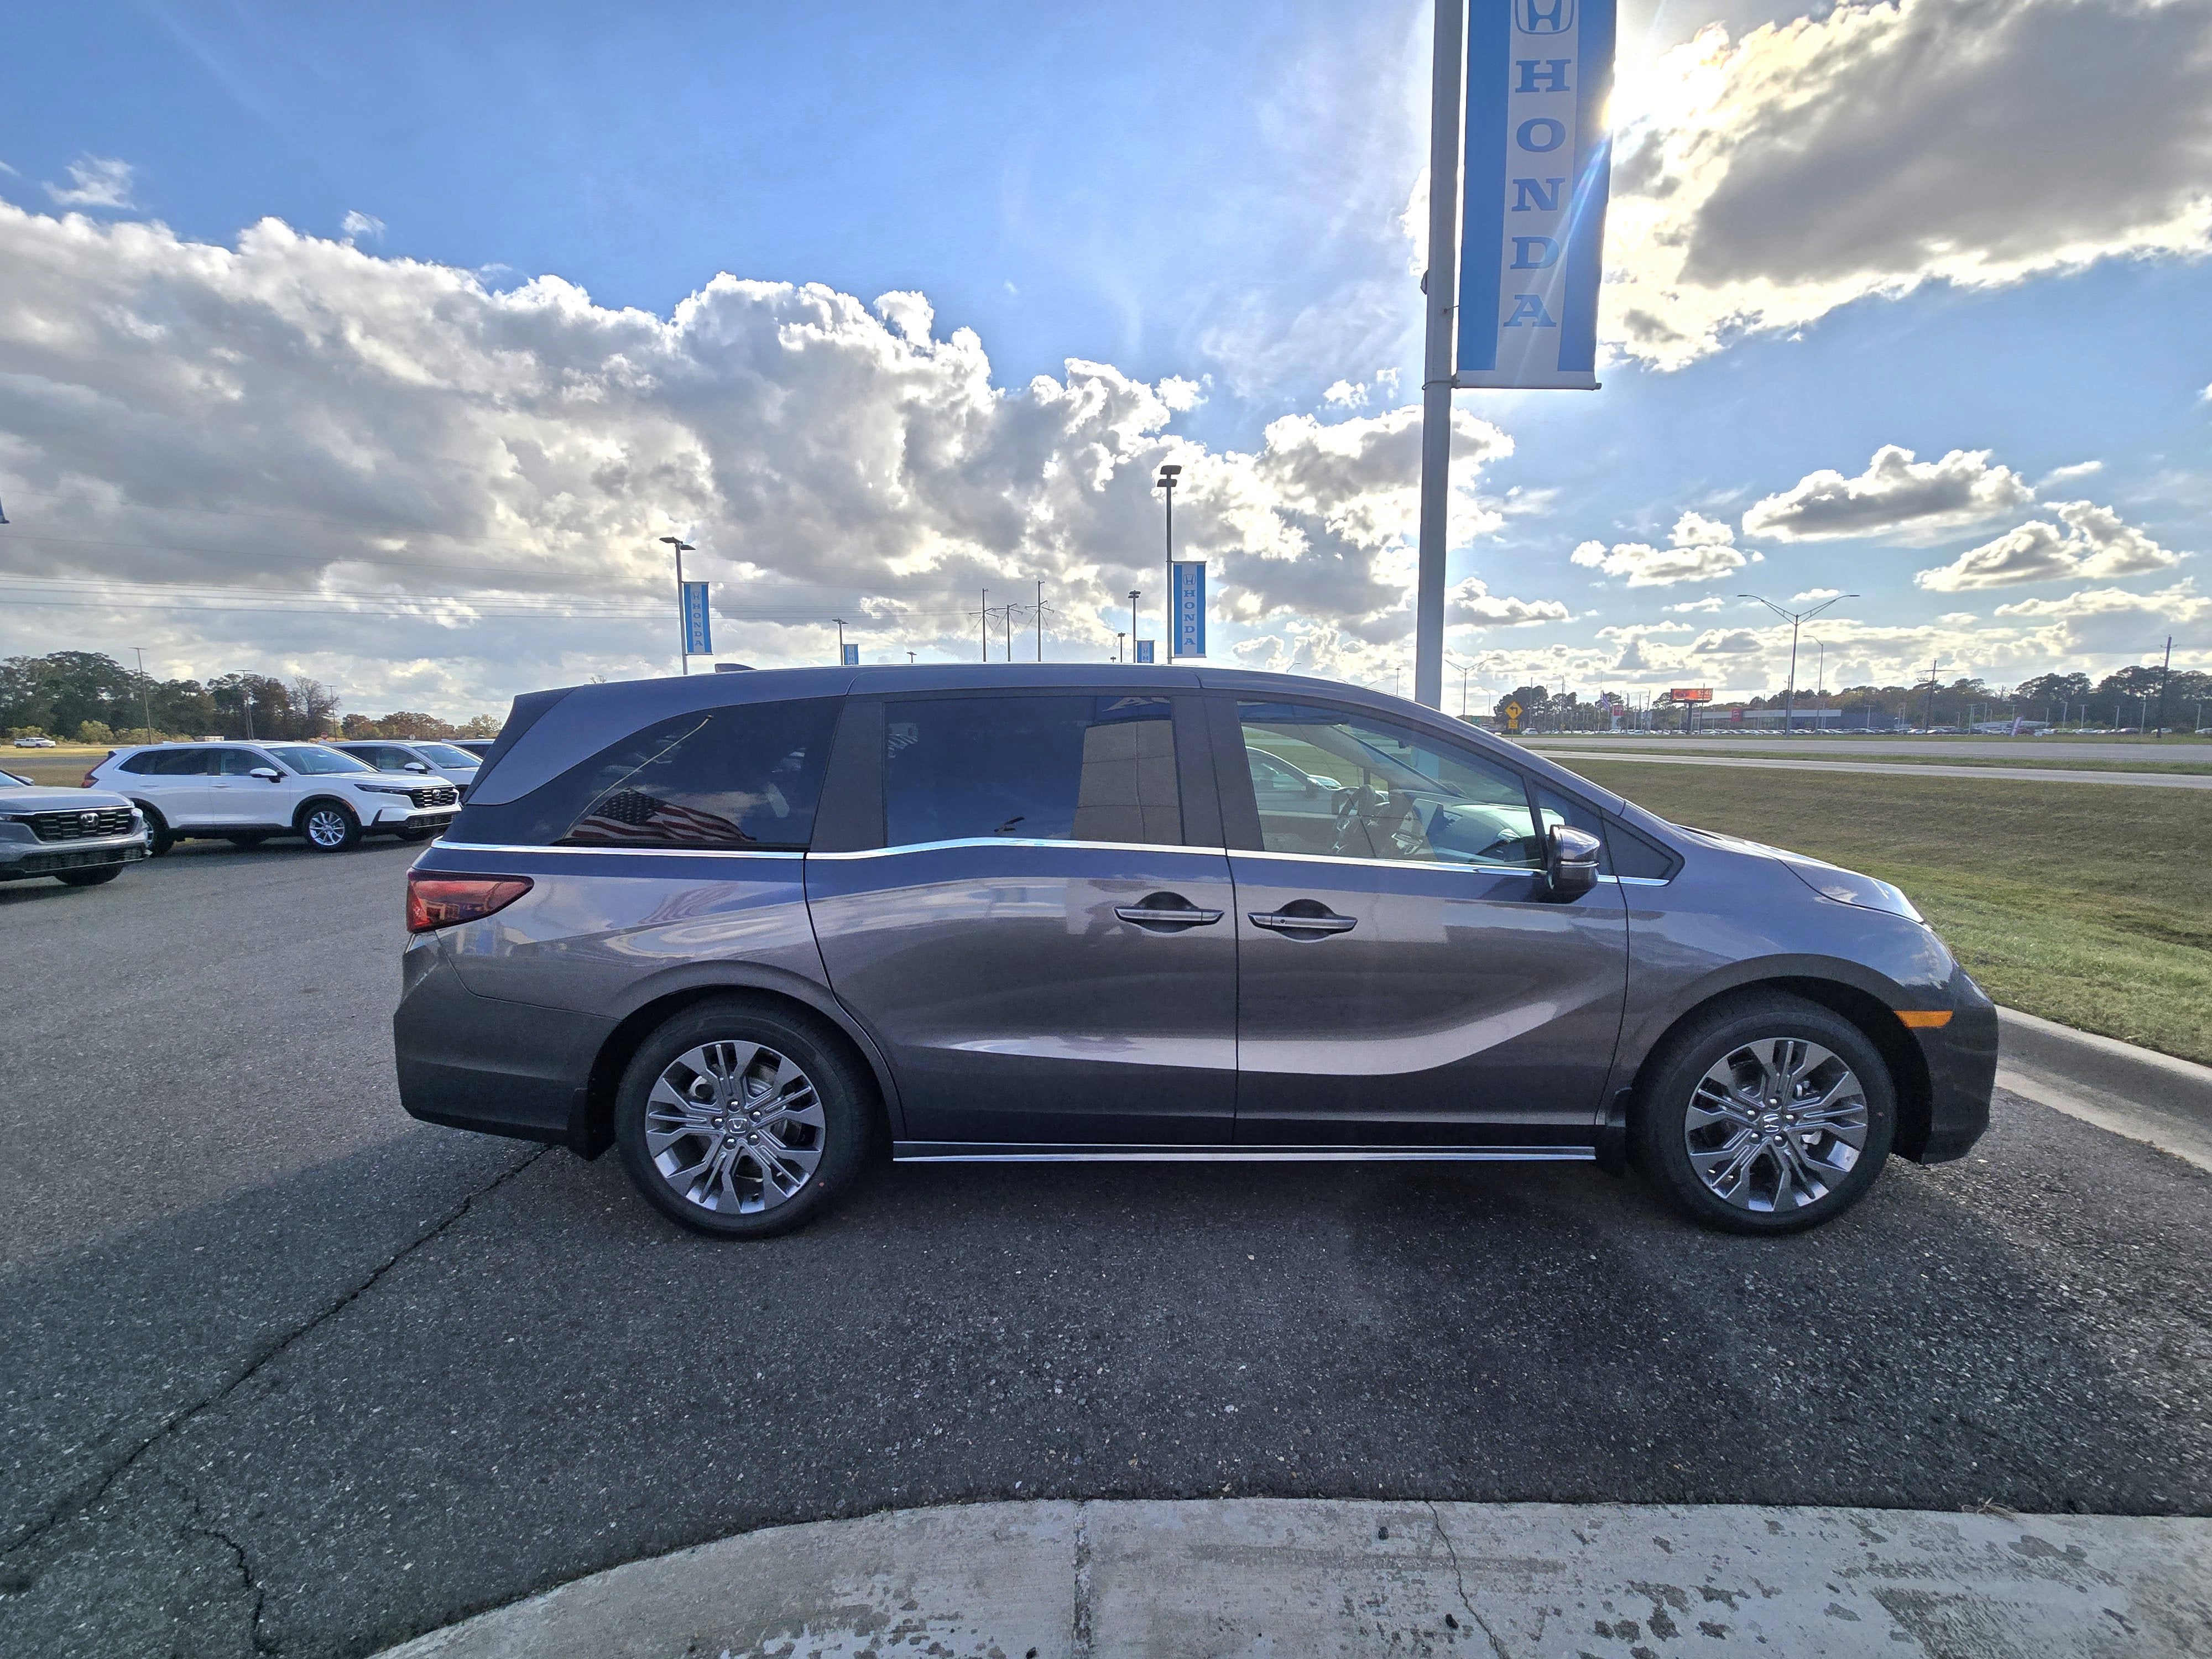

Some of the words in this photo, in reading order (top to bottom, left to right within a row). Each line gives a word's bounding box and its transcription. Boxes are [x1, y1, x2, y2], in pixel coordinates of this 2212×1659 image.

[1503, 59, 1572, 327] HONDA
[693, 603, 703, 646] HONDA
[1183, 589, 1196, 645] HONDA
